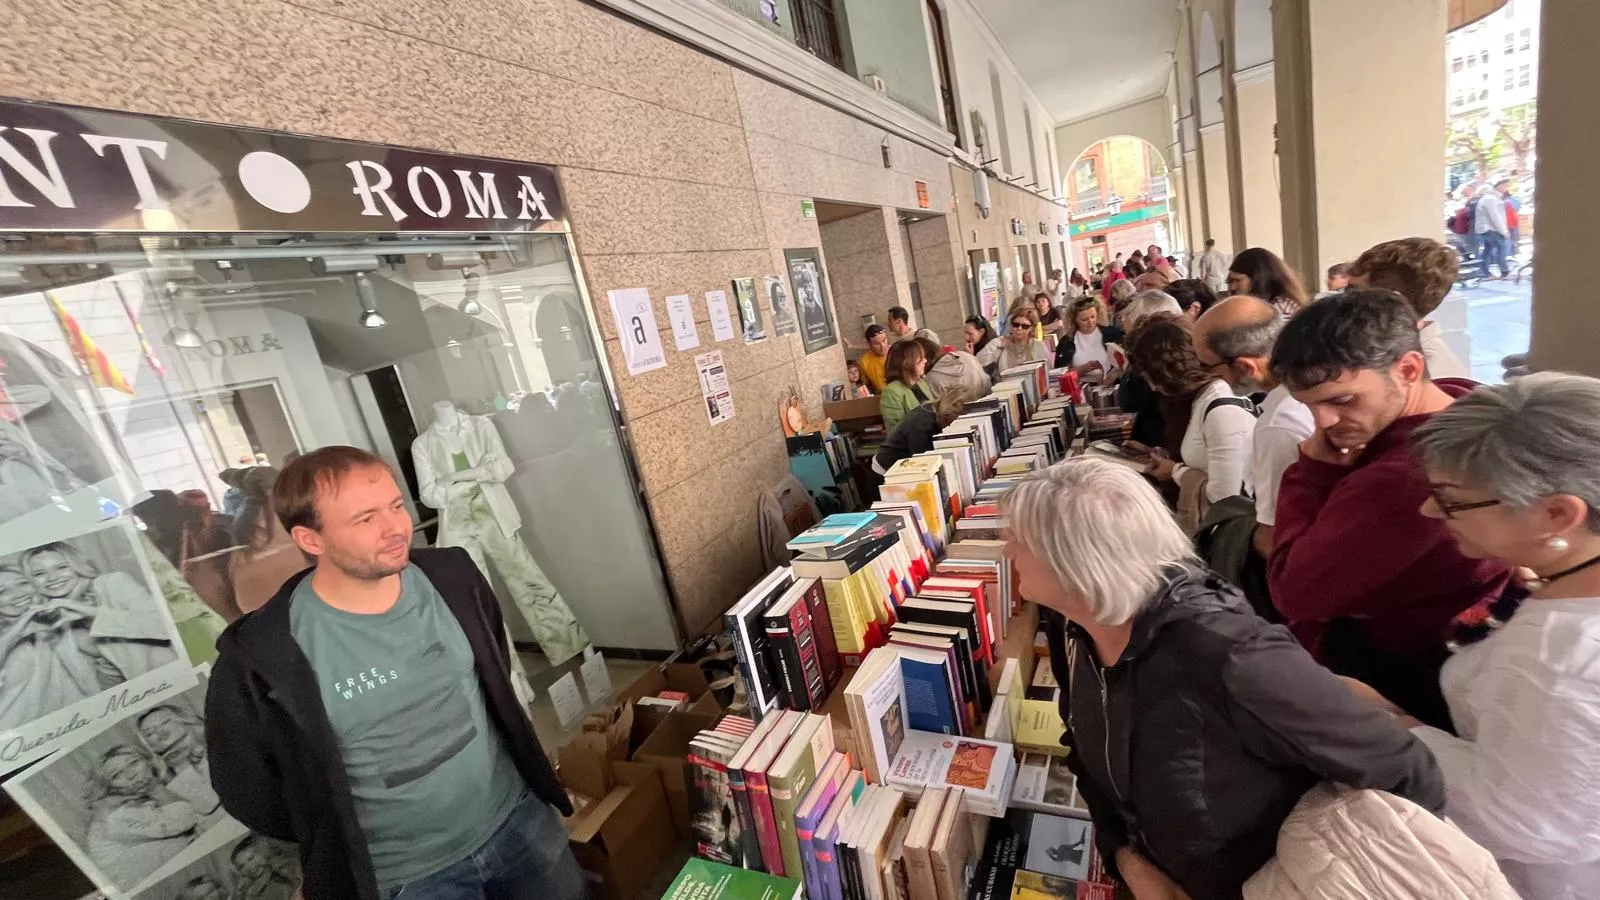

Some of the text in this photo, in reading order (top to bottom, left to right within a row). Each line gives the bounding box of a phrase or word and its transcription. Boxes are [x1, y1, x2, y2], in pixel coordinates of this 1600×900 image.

[345, 160, 554, 222] ROMA
[631, 316, 647, 345] a
[192, 333, 285, 361] OMA
[335, 667, 379, 692] FREE
[342, 670, 398, 699] WINGS
[2, 712, 95, 761] Querida
